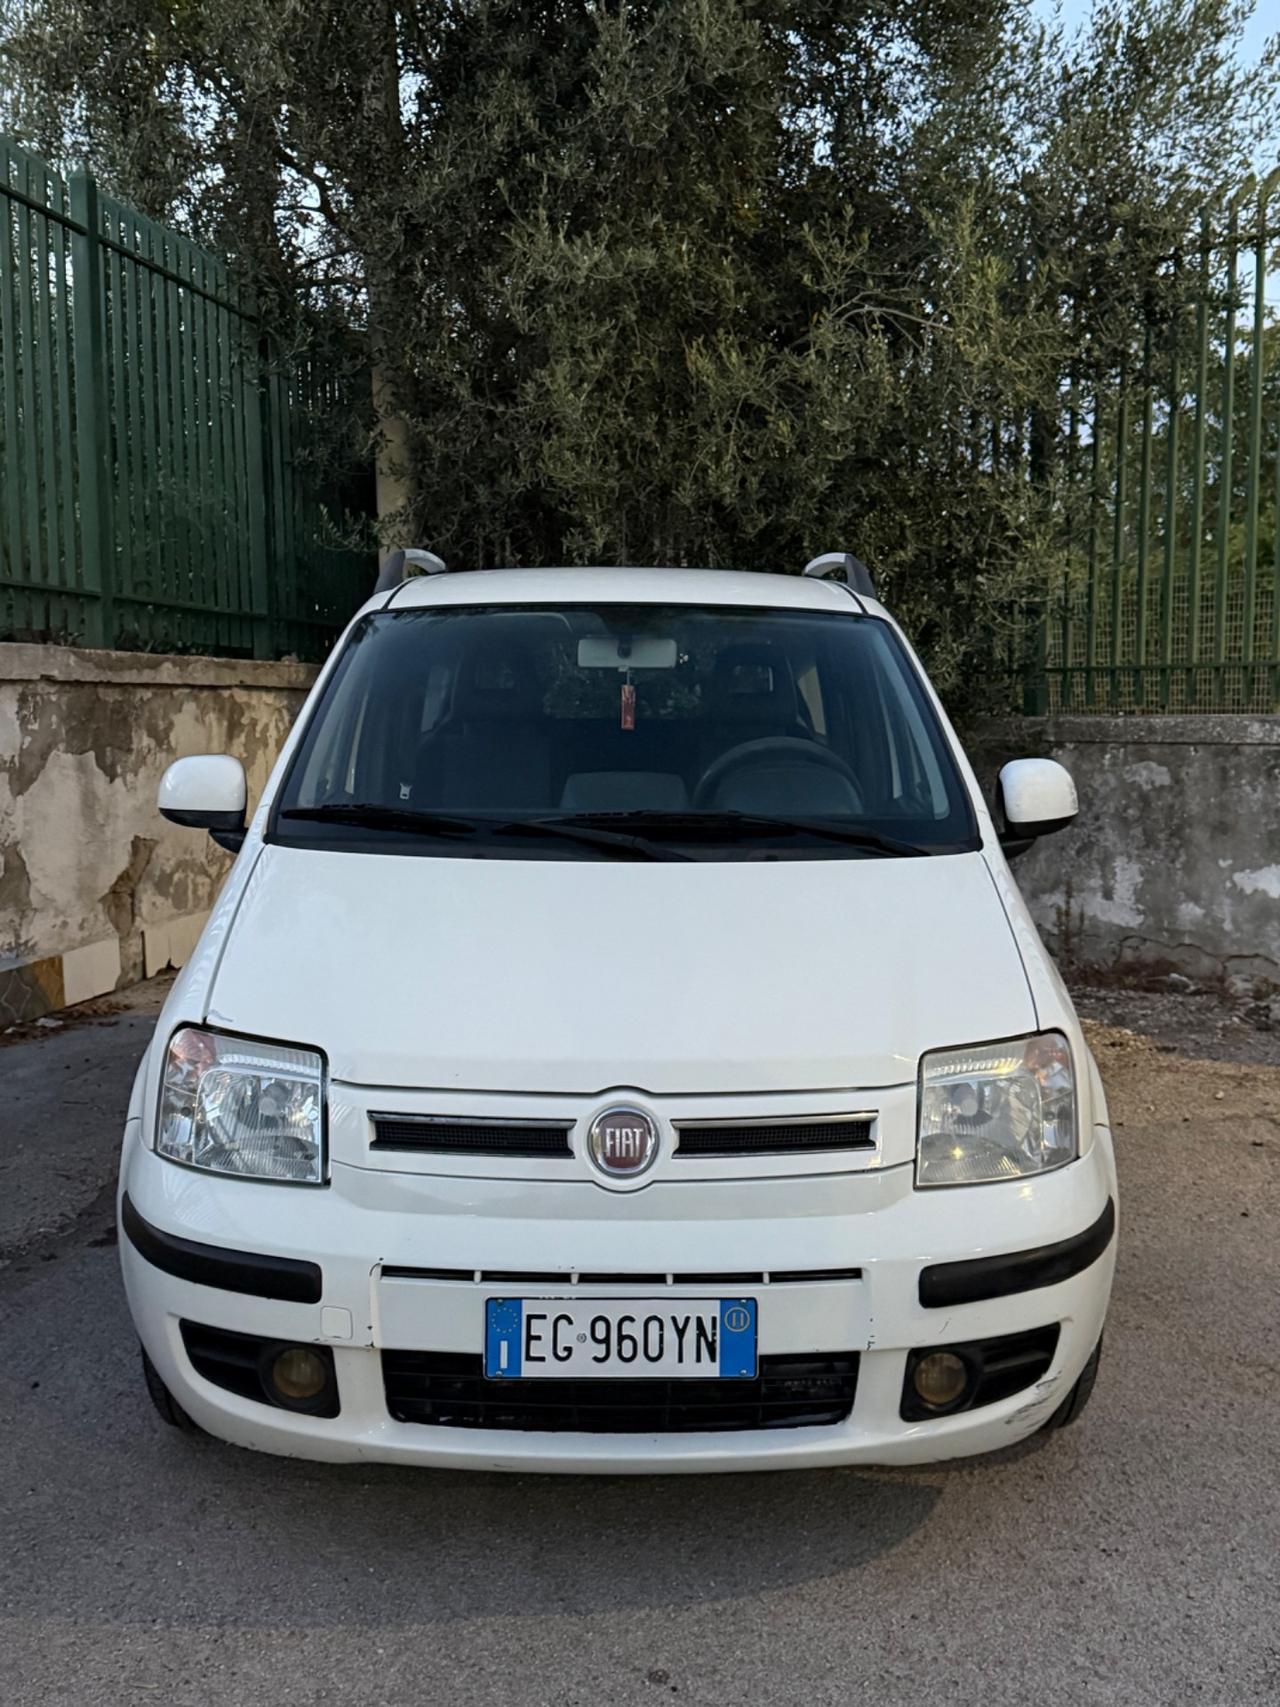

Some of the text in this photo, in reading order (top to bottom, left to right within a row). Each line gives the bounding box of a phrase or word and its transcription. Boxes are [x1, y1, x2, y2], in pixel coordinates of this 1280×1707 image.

[605, 1127, 644, 1158] FIAT
[525, 1314, 717, 1363] EG 960YN
